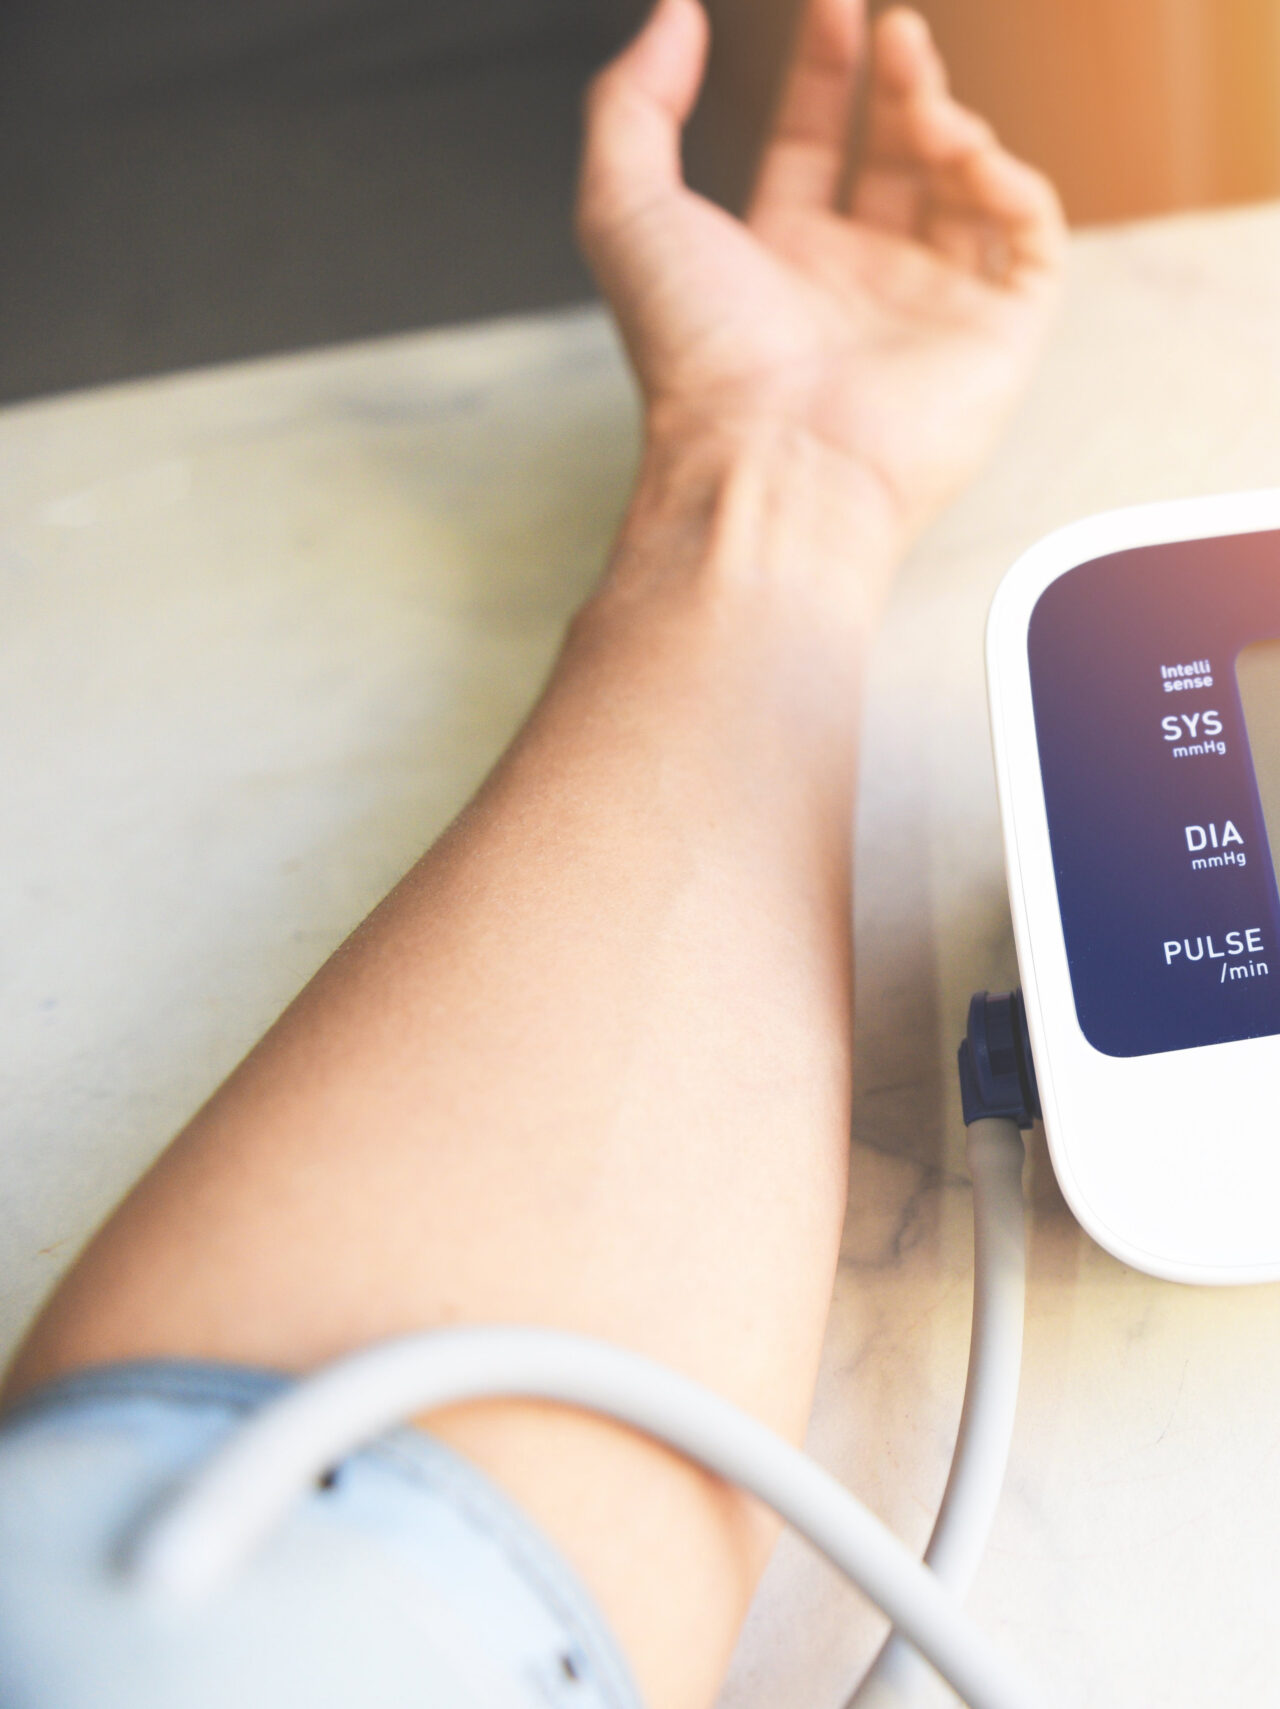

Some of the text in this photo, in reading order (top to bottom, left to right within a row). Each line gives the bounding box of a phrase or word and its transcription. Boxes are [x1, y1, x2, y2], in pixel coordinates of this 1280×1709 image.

[1160, 659, 1211, 679] Intelli
[1163, 675, 1213, 692] sense
[1161, 710, 1223, 741] SYS
[1172, 740, 1227, 758] mmHg
[1185, 820, 1244, 852] DIA
[1192, 851, 1247, 870] mmHg
[1163, 928, 1264, 965] PULSE
[1220, 960, 1269, 983] /min
